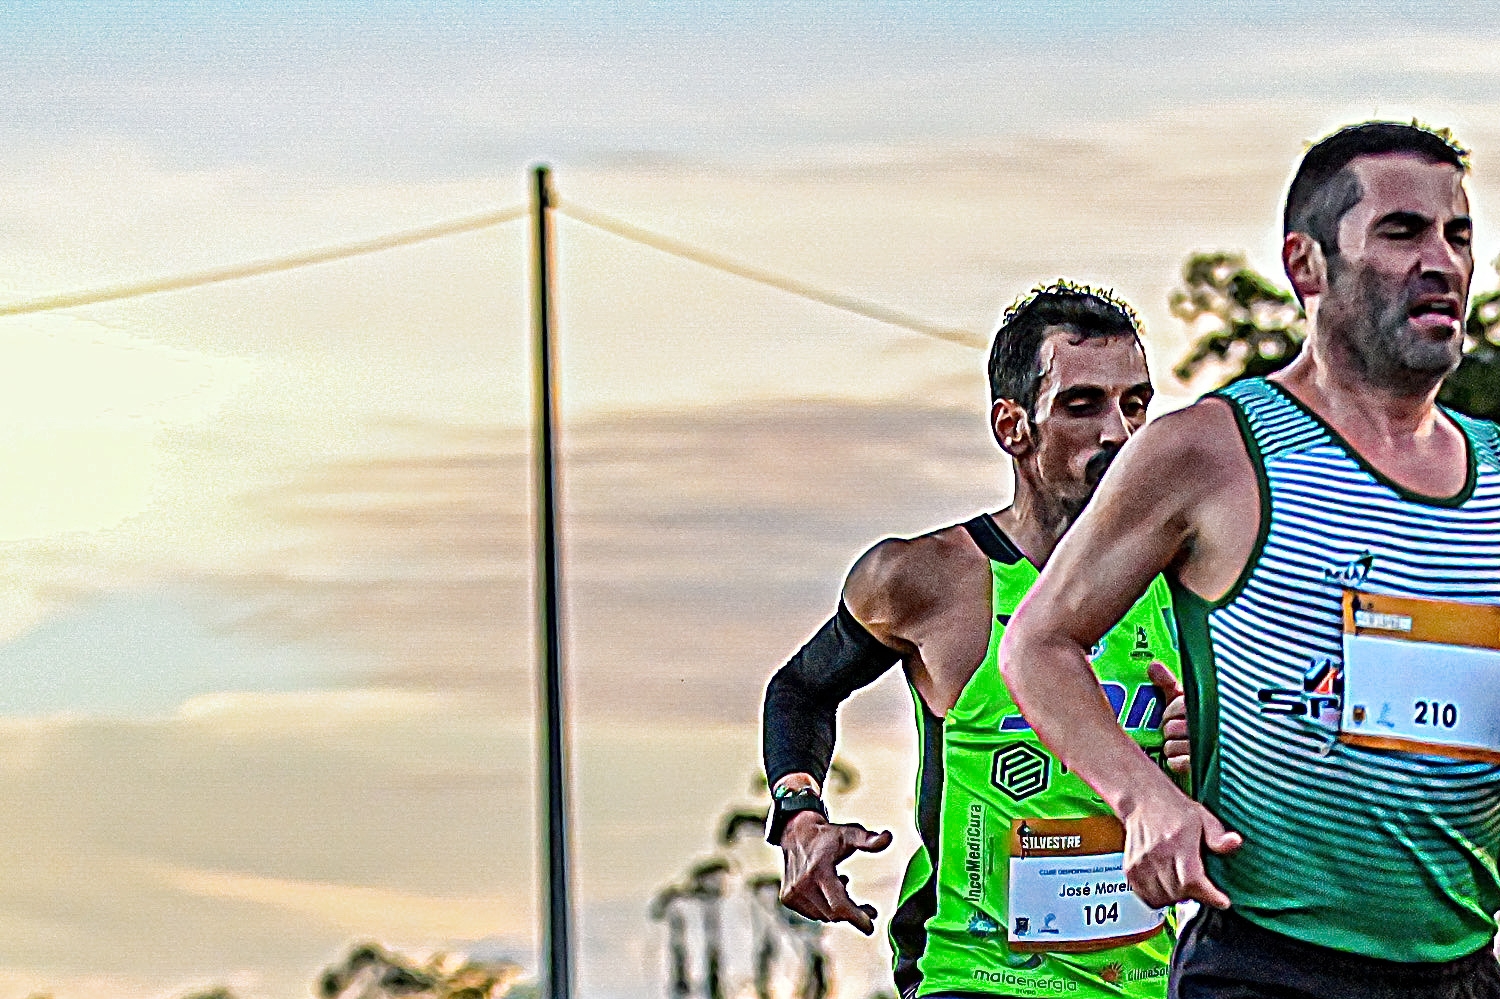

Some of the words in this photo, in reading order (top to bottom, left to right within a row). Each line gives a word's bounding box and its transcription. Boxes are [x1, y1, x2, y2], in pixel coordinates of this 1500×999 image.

[1414, 701, 1457, 728] 210
[1022, 835, 1081, 850] SILVESTRE
[1059, 882, 1091, 897] José
[1083, 902, 1118, 926] 104
[974, 969, 1077, 993] maiaenergia
